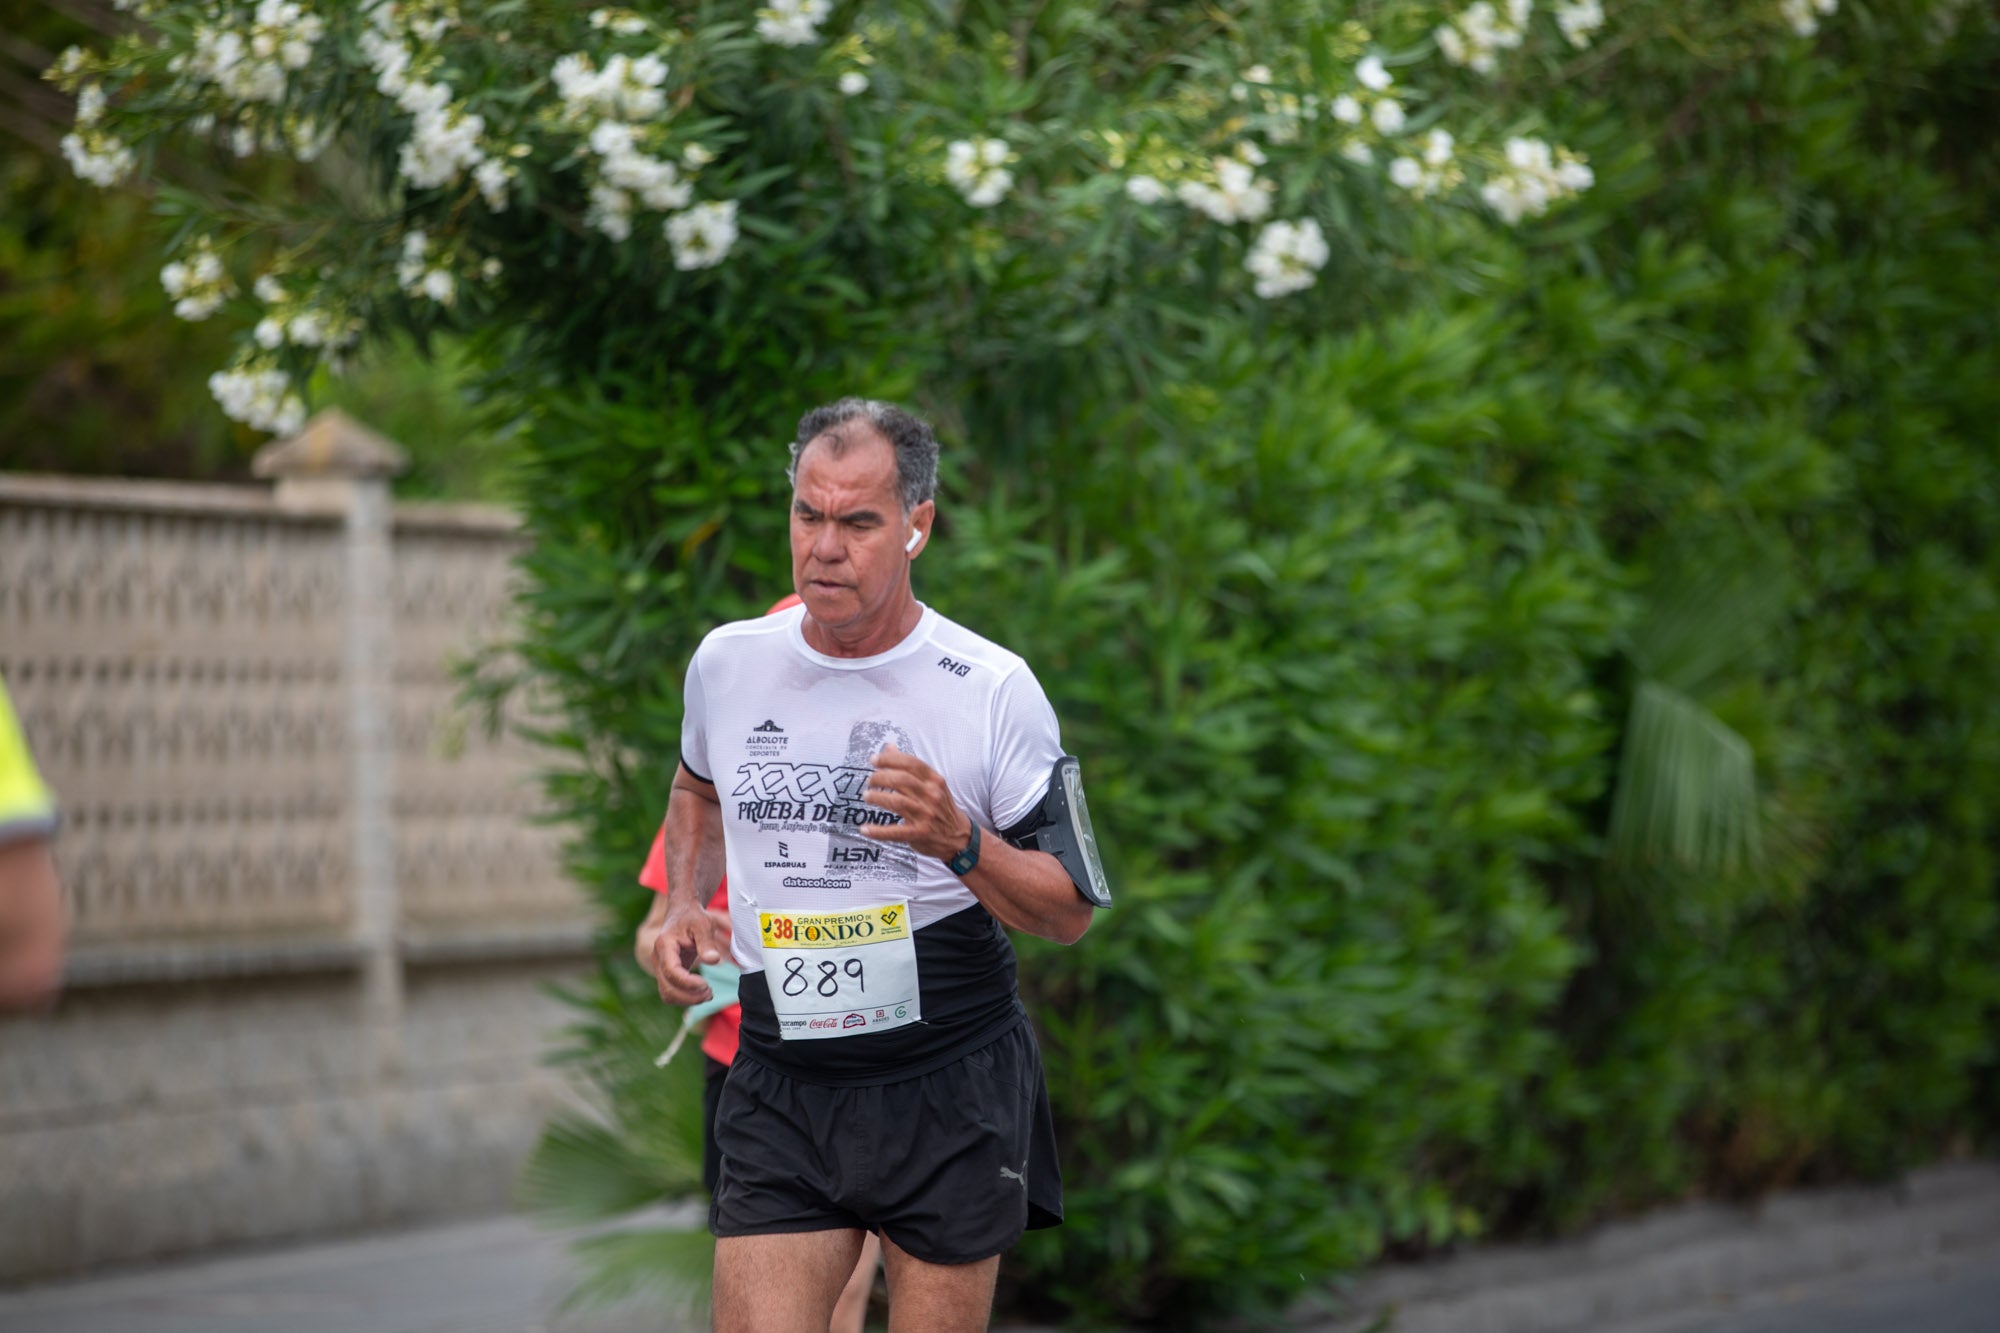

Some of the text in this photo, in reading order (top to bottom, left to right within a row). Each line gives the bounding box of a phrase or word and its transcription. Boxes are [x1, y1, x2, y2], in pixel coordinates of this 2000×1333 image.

[746, 736, 789, 744] ALBOLOTE
[732, 763, 890, 806] XXXI
[738, 801, 806, 823] PRUEBA
[813, 804, 838, 822] DE
[832, 847, 880, 863] HSN
[764, 861, 806, 869] ESPAGRUAS
[783, 877, 851, 889] datacol.com
[773, 918, 793, 939] 38
[797, 917, 822, 925] GRAN
[824, 914, 864, 925] PREMIO
[793, 921, 874, 941] FONDO
[782, 957, 865, 997] 889
